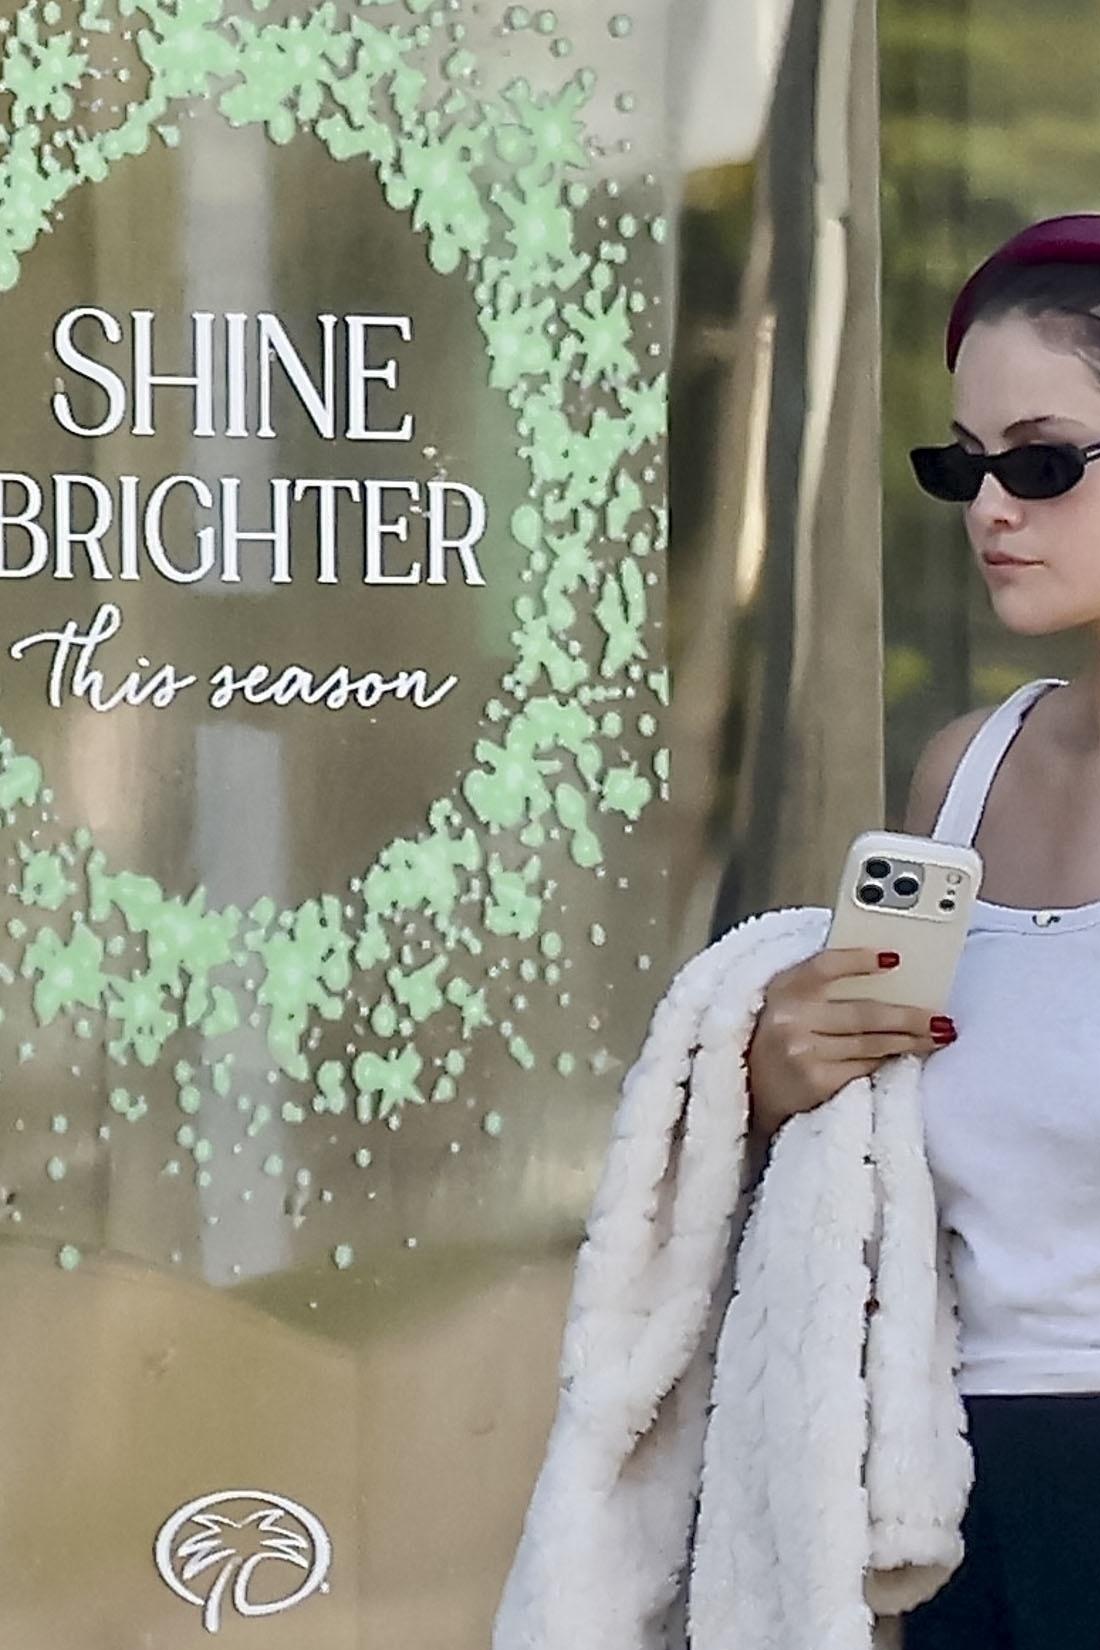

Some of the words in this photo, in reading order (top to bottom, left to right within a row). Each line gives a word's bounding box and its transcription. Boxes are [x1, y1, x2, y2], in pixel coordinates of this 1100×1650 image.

[52, 308, 413, 441] SHINE
[0, 472, 487, 586] BRIGHTER
[209, 662, 458, 709] season
